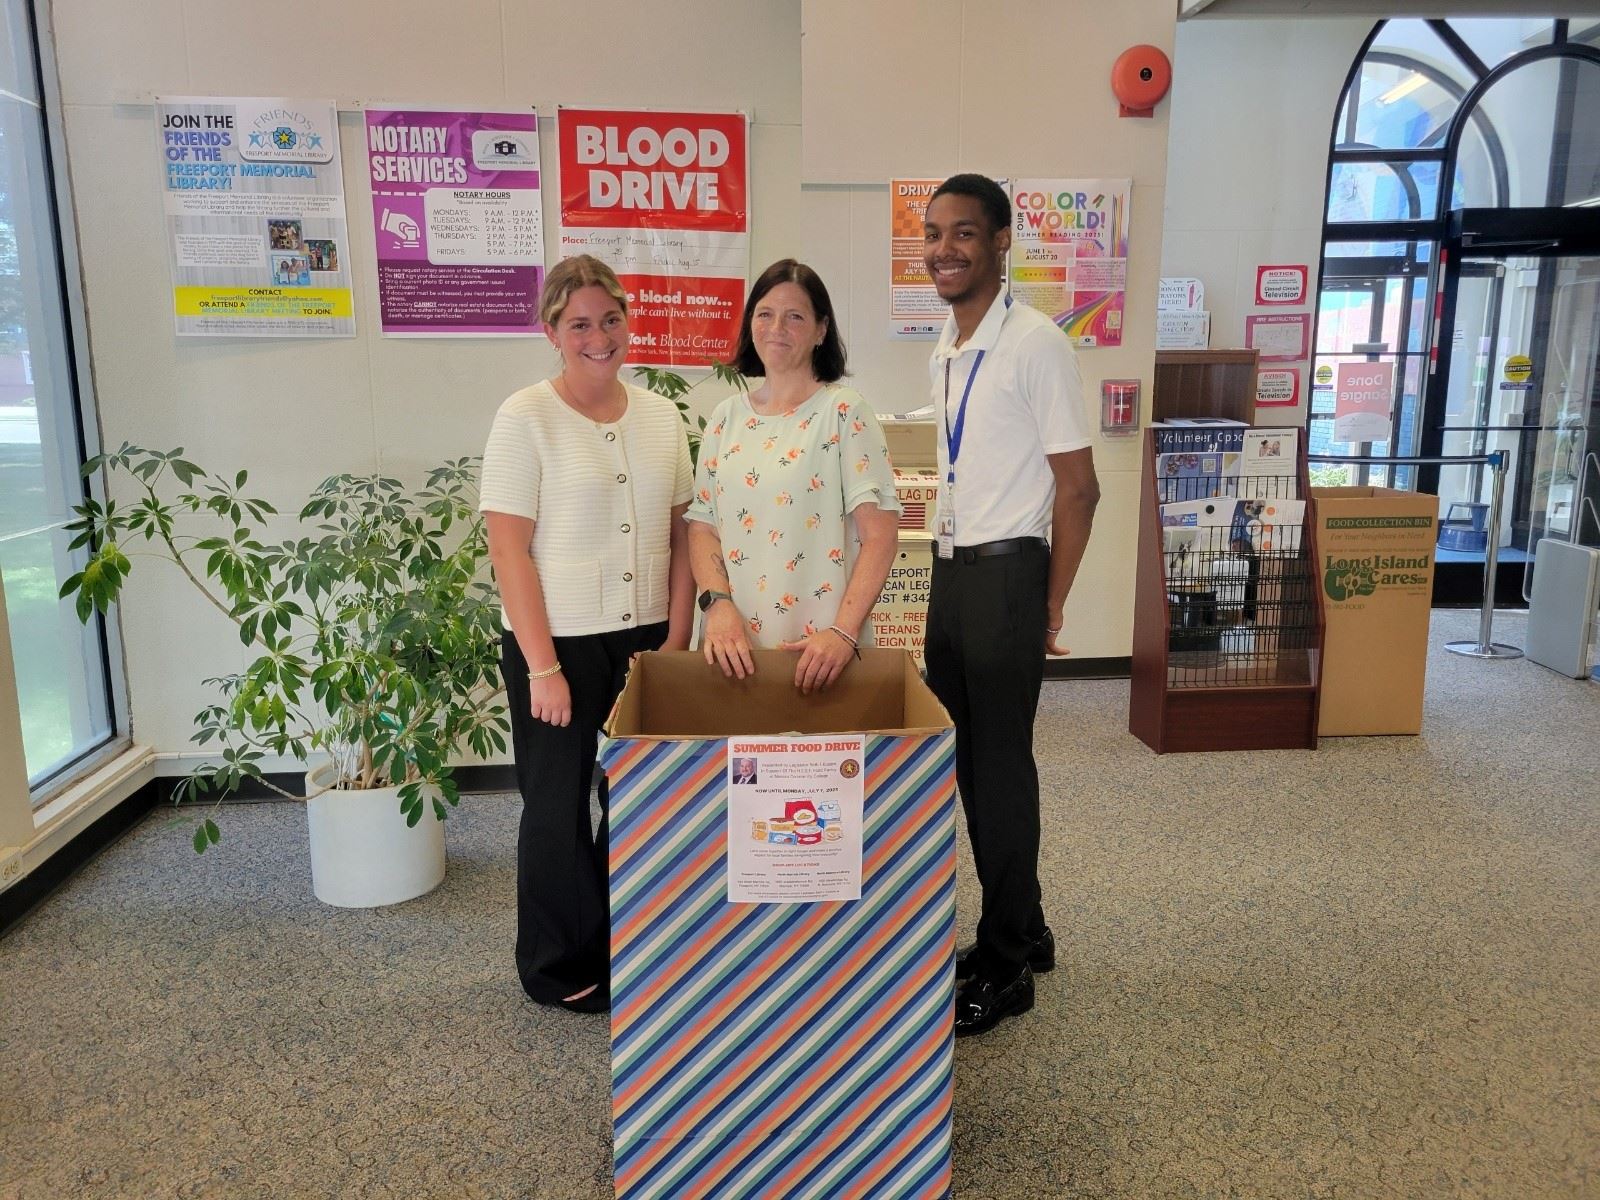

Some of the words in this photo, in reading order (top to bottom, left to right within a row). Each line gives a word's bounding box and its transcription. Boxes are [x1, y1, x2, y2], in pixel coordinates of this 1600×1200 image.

[163, 115, 201, 129] JOIN
[204, 116, 234, 128] THE
[254, 109, 314, 131] FRIENDS
[164, 131, 232, 147] FRIENDS
[370, 126, 448, 154] NOTARY
[166, 147, 189, 161] OF
[192, 148, 222, 162] THE
[576, 126, 729, 168] BLOOD
[167, 164, 237, 177] FREEPORT
[240, 164, 317, 179] MEMORIAL
[372, 156, 468, 184] SERVICES
[168, 177, 233, 190] LIBRARY!
[589, 170, 719, 211] DRIVE
[486, 192, 511, 200] HOURS
[1016, 192, 1088, 210] COLOR
[906, 200, 921, 208] THE
[1017, 212, 1025, 231] OUR
[1026, 211, 1106, 232] WORLD!
[562, 236, 588, 244] Place:
[640, 289, 682, 305] blood
[686, 295, 733, 307] now...
[649, 308, 668, 318] can't
[670, 308, 686, 318] live
[688, 310, 721, 319] without
[722, 311, 732, 319] it.
[660, 334, 691, 348] Blood
[692, 335, 730, 349] Center
[1328, 518, 1354, 528] FOOD
[1356, 518, 1414, 527] COLLECTION
[1414, 518, 1430, 526] BIN
[1325, 555, 1375, 573] Long
[1374, 554, 1430, 569] Island
[1368, 570, 1418, 585] Cares
[874, 625, 921, 635] TERANS
[734, 744, 789, 753] SUMMER
[791, 743, 823, 752] FOOD
[824, 742, 861, 752] DRIVE
